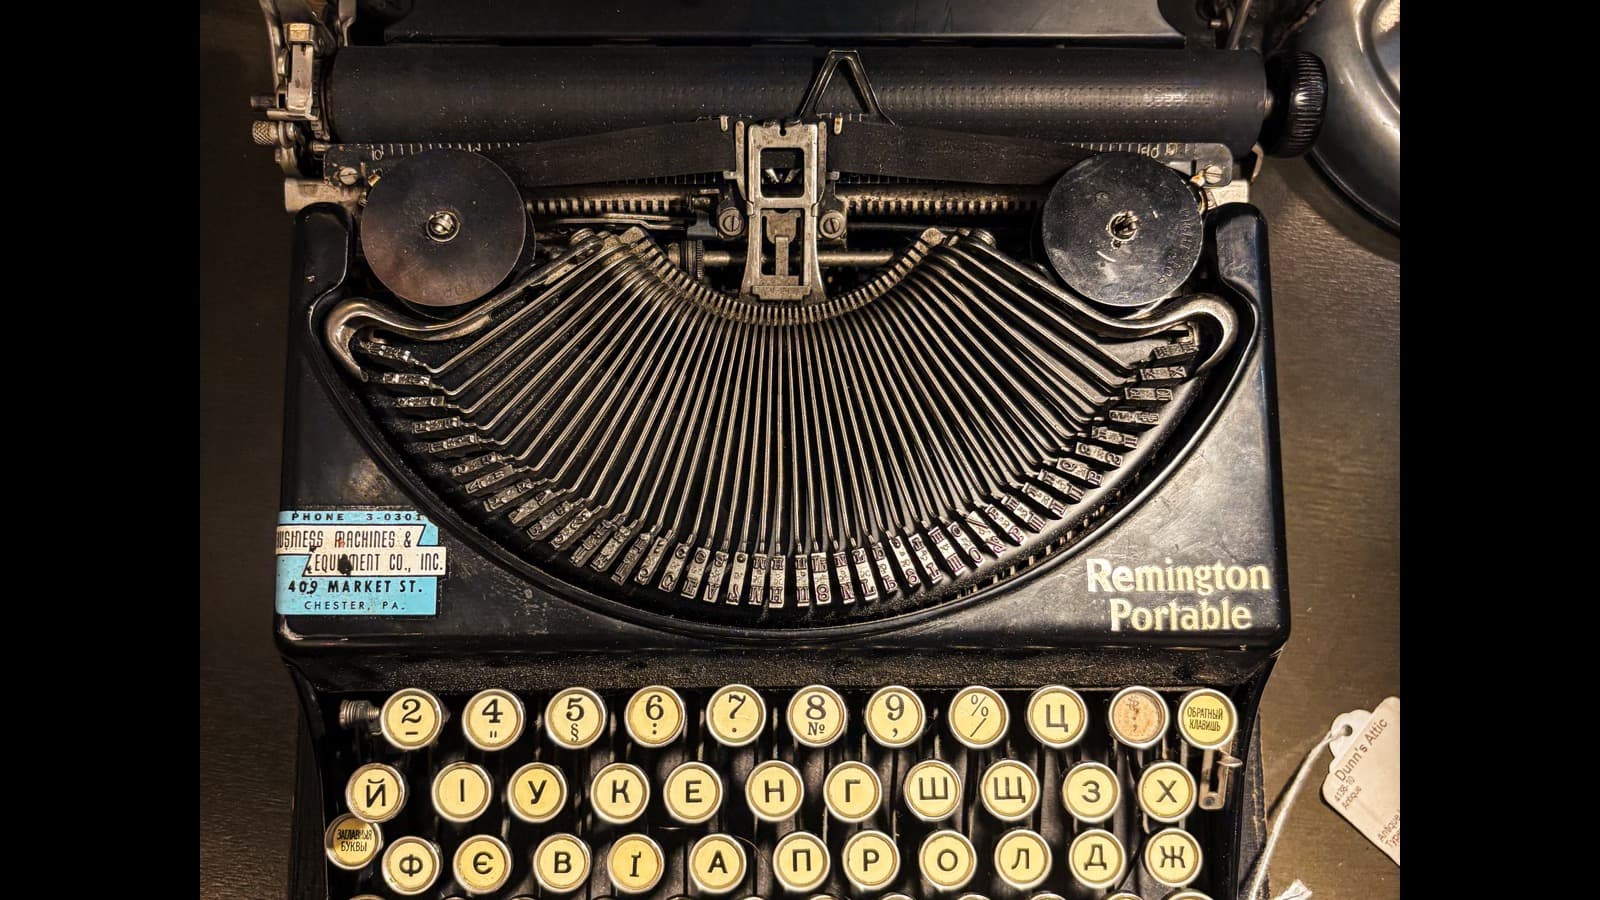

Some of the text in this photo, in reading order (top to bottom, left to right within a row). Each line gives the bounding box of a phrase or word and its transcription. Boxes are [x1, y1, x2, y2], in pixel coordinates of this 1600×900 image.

[292, 513, 422, 521] PHONE 3-0301
[334, 530, 395, 548] MACHINES
[404, 530, 411, 548] &
[389, 553, 411, 572] CO.,
[421, 553, 443, 571] INC.
[288, 580, 423, 594] 409 MARKET ST.
[1086, 557, 1272, 595] Remington
[305, 601, 406, 611] CHESTER, PA.
[1109, 596, 1253, 632] Portable
[401, 698, 422, 724] 2
[481, 698, 504, 724] 4
[566, 697, 585, 721] 5
[645, 694, 665, 721] 6
[728, 693, 747, 720] 7
[805, 694, 827, 721] 8
[884, 693, 905, 721] 9
[970, 694, 989, 717] %
[808, 722, 825, 735] №
[1045, 703, 1069, 733] Ц
[570, 723, 580, 743] §
[1334, 718, 1388, 782] Dunn's Attic
[366, 778, 386, 808] Й
[528, 780, 547, 804] У
[612, 780, 630, 803] К
[686, 780, 702, 803] Е
[765, 780, 784, 803] Н
[845, 780, 860, 802] Г
[919, 774, 951, 800] Ш
[993, 775, 1026, 804] Щ
[1082, 780, 1100, 803] З
[1156, 780, 1177, 803] Х
[1342, 786, 1362, 810] Antique
[341, 841, 368, 852] БУКВЫ
[1084, 845, 1107, 871] Д
[1160, 846, 1185, 868] Ж
[399, 854, 423, 877] Ф
[473, 852, 493, 874] Є
[554, 851, 571, 873] В
[708, 851, 728, 873] А
[793, 849, 811, 872] П
[863, 849, 879, 871] Р
[937, 849, 958, 871] О
[1012, 848, 1029, 869] Л
